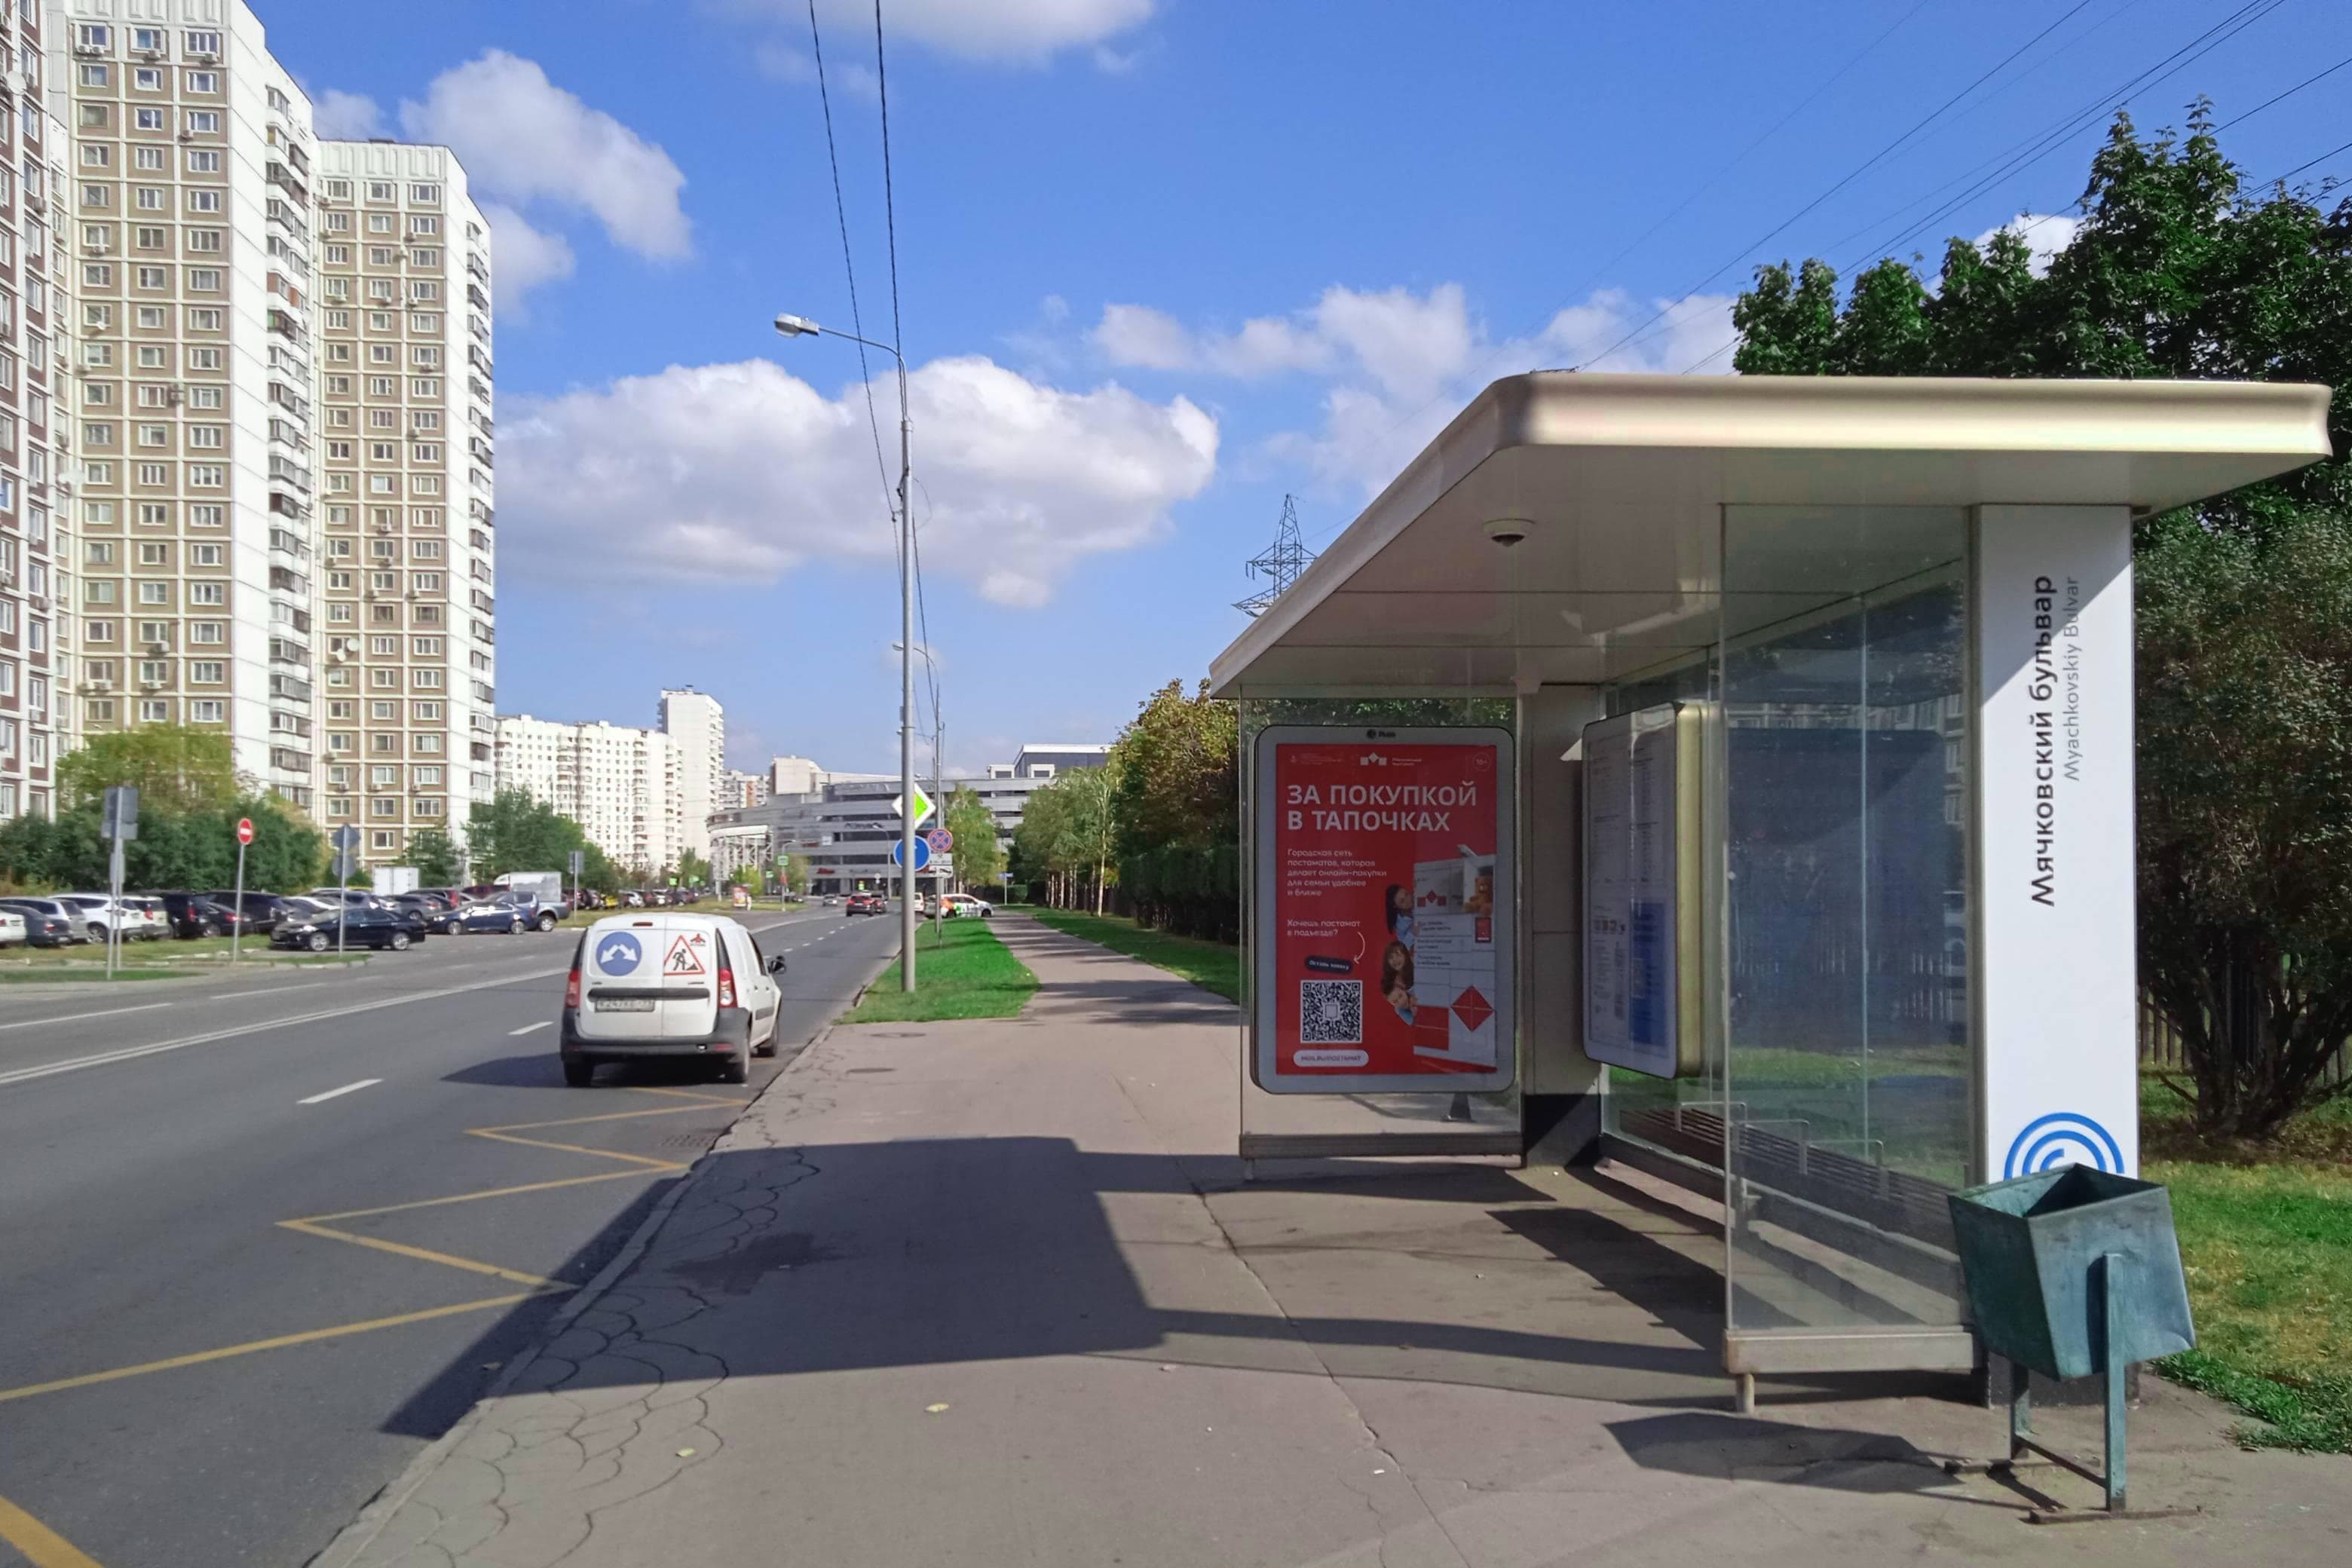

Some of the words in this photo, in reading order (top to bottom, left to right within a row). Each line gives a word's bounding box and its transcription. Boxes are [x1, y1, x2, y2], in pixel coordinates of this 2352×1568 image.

[2063, 577, 2081, 637] Bulvar
[2029, 575, 2057, 701] бульвар
[2063, 642, 2083, 781] Myachkovskiy
[1288, 785, 1321, 805] ЗА
[1330, 780, 1477, 807] ПОКУПКОЙ
[1288, 810, 1303, 831] В
[1312, 810, 1450, 831] ТАПОЧКАХ
[2029, 711, 2054, 907] Мячковский
[1287, 848, 1332, 858] Городская
[1332, 879, 1367, 888] удобнее
[1287, 919, 1318, 927] Хочешь
[1294, 928, 1339, 937] подъезде?
